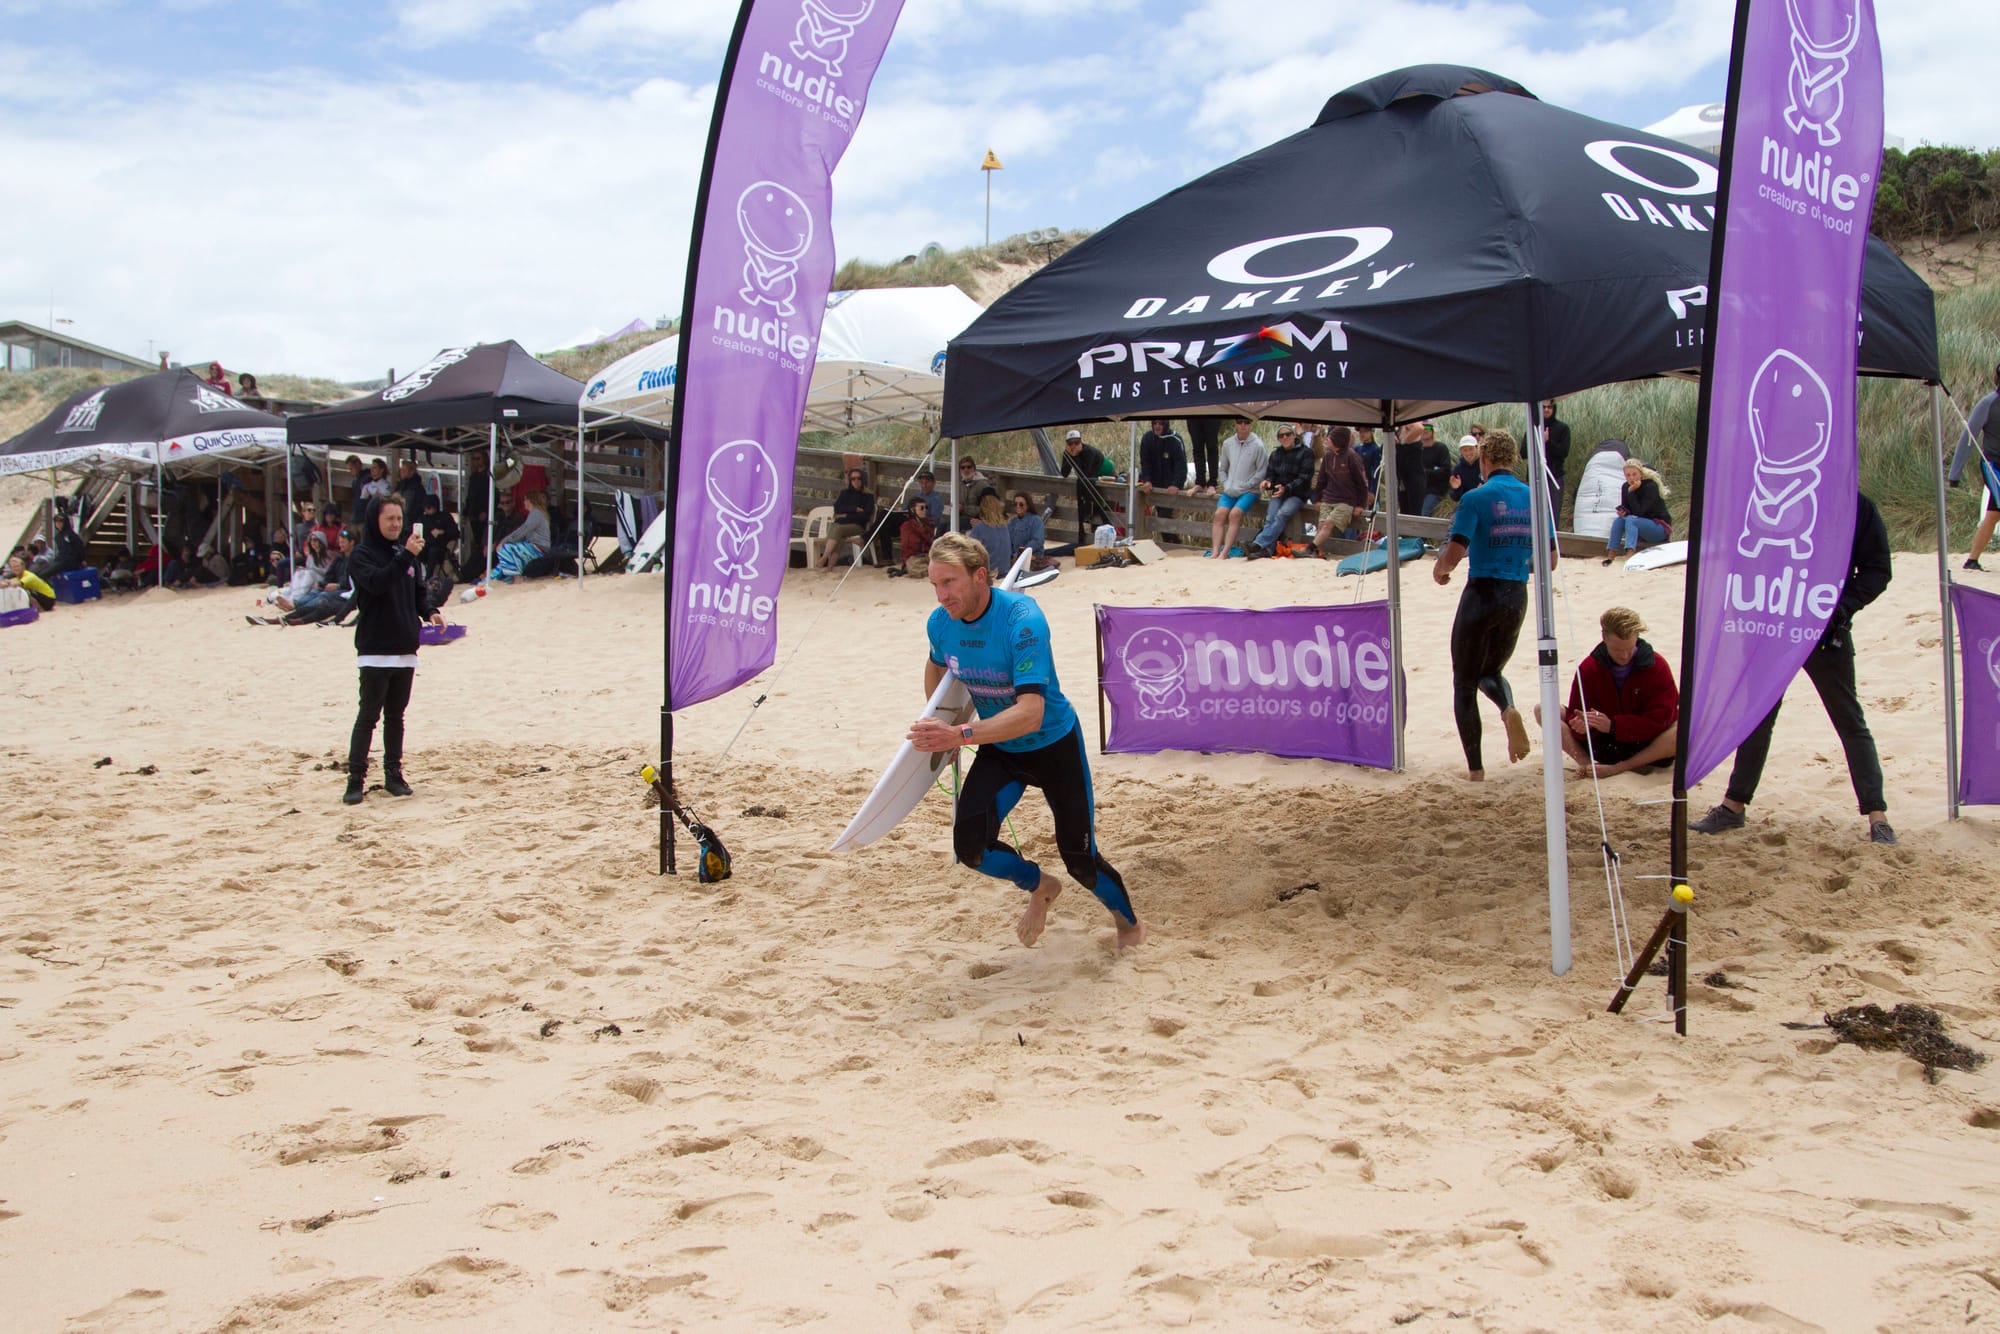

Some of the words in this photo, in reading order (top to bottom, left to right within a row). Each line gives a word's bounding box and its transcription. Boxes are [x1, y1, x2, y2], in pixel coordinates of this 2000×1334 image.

[756, 78, 804, 108] creators
[760, 51, 854, 120] nudie
[1760, 135, 1860, 211] nudie
[1601, 192, 1716, 231] OAK
[1758, 184, 1808, 215] creators
[1123, 264, 1410, 319] OAKLEY
[714, 305, 810, 359] nudie
[1077, 320, 1348, 379] PRIZM
[712, 335, 764, 357] creators
[780, 357, 805, 375] good
[1077, 381, 1141, 402] LENS
[1163, 361, 1349, 395] TECHNOLOGY
[1492, 536, 1532, 546] BATTL
[1724, 566, 1839, 620] udie
[720, 617, 736, 628] of
[737, 620, 766, 636] good
[1724, 617, 1766, 635] ators
[1766, 622, 1785, 638] of
[1194, 624, 1389, 692] nudie
[1200, 695, 1302, 716] creators
[1309, 695, 1332, 718] of
[1336, 701, 1389, 725] good
